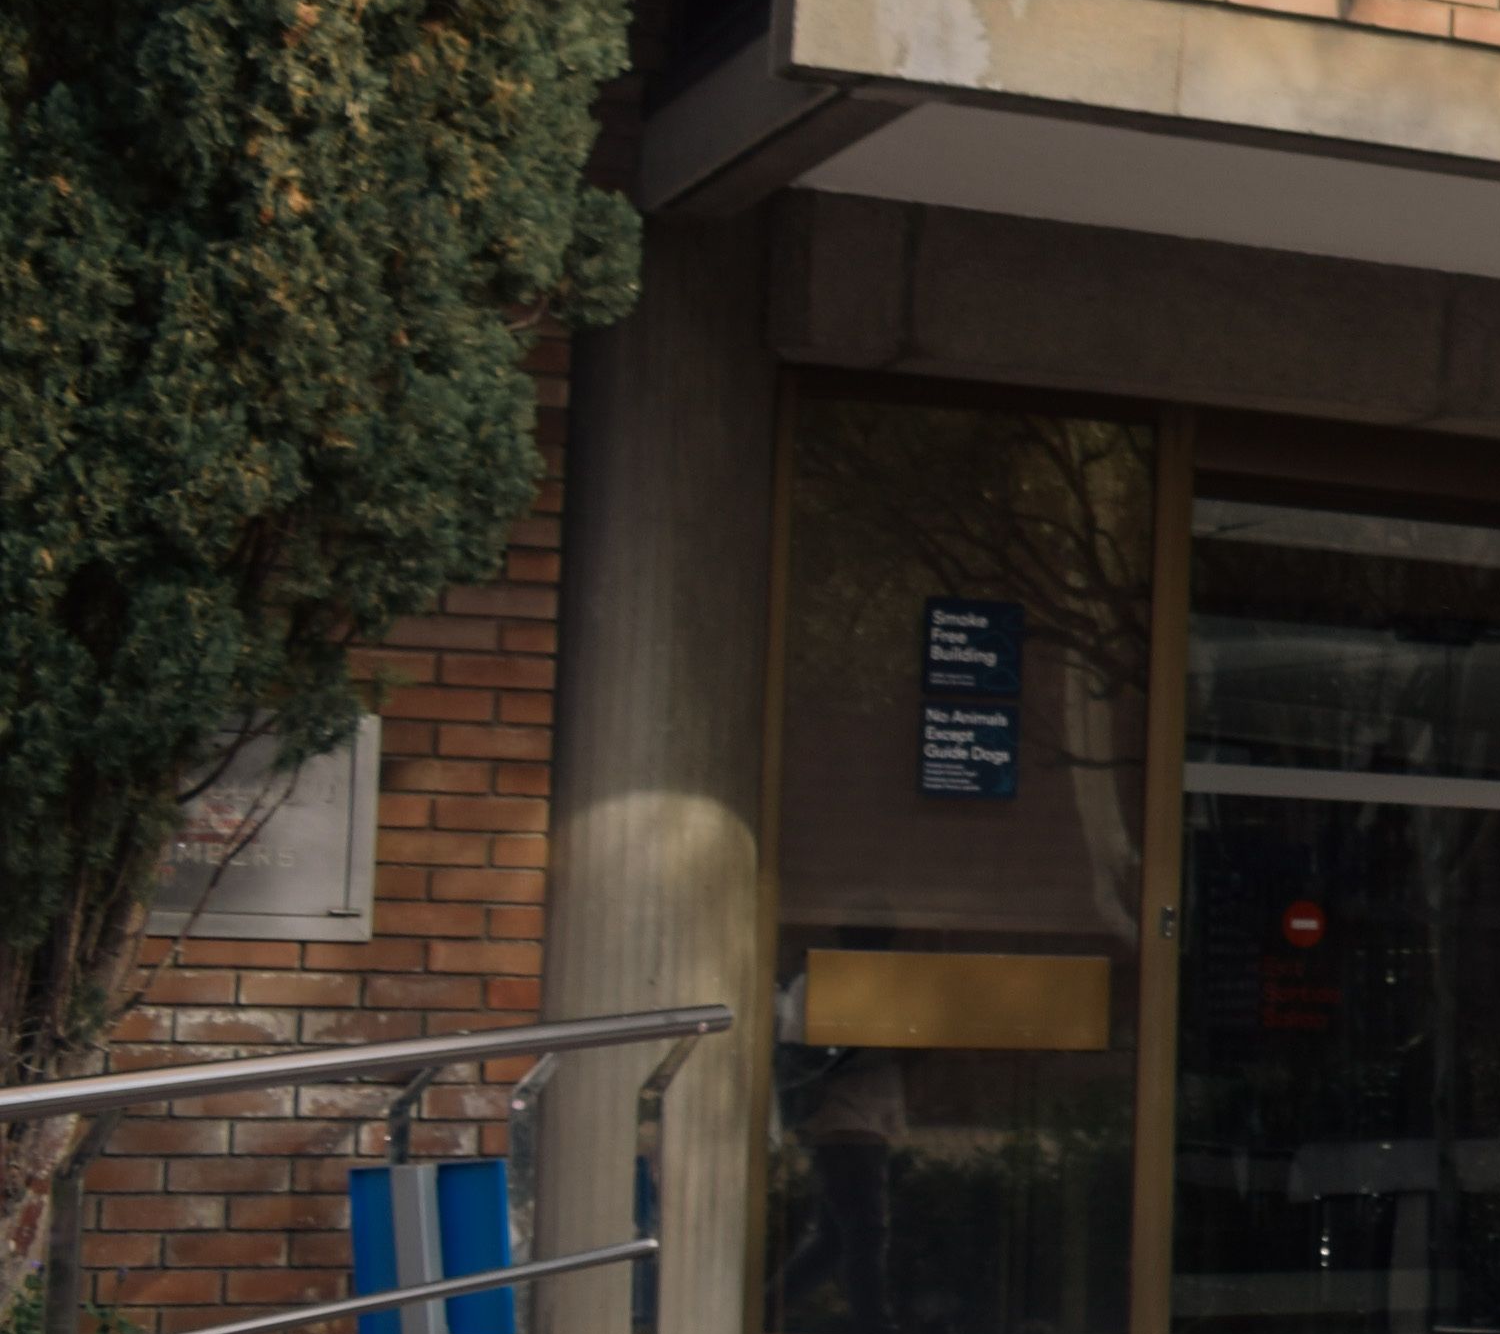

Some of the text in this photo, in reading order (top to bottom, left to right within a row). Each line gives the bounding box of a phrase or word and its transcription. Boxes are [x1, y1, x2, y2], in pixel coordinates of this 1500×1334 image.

[931, 609, 989, 629] Smoke
[930, 626, 968, 645] Free
[929, 645, 998, 668] Building
[925, 707, 1009, 727] No Animals
[924, 724, 975, 743] Except
[923, 743, 1011, 765] Guide Dogs
